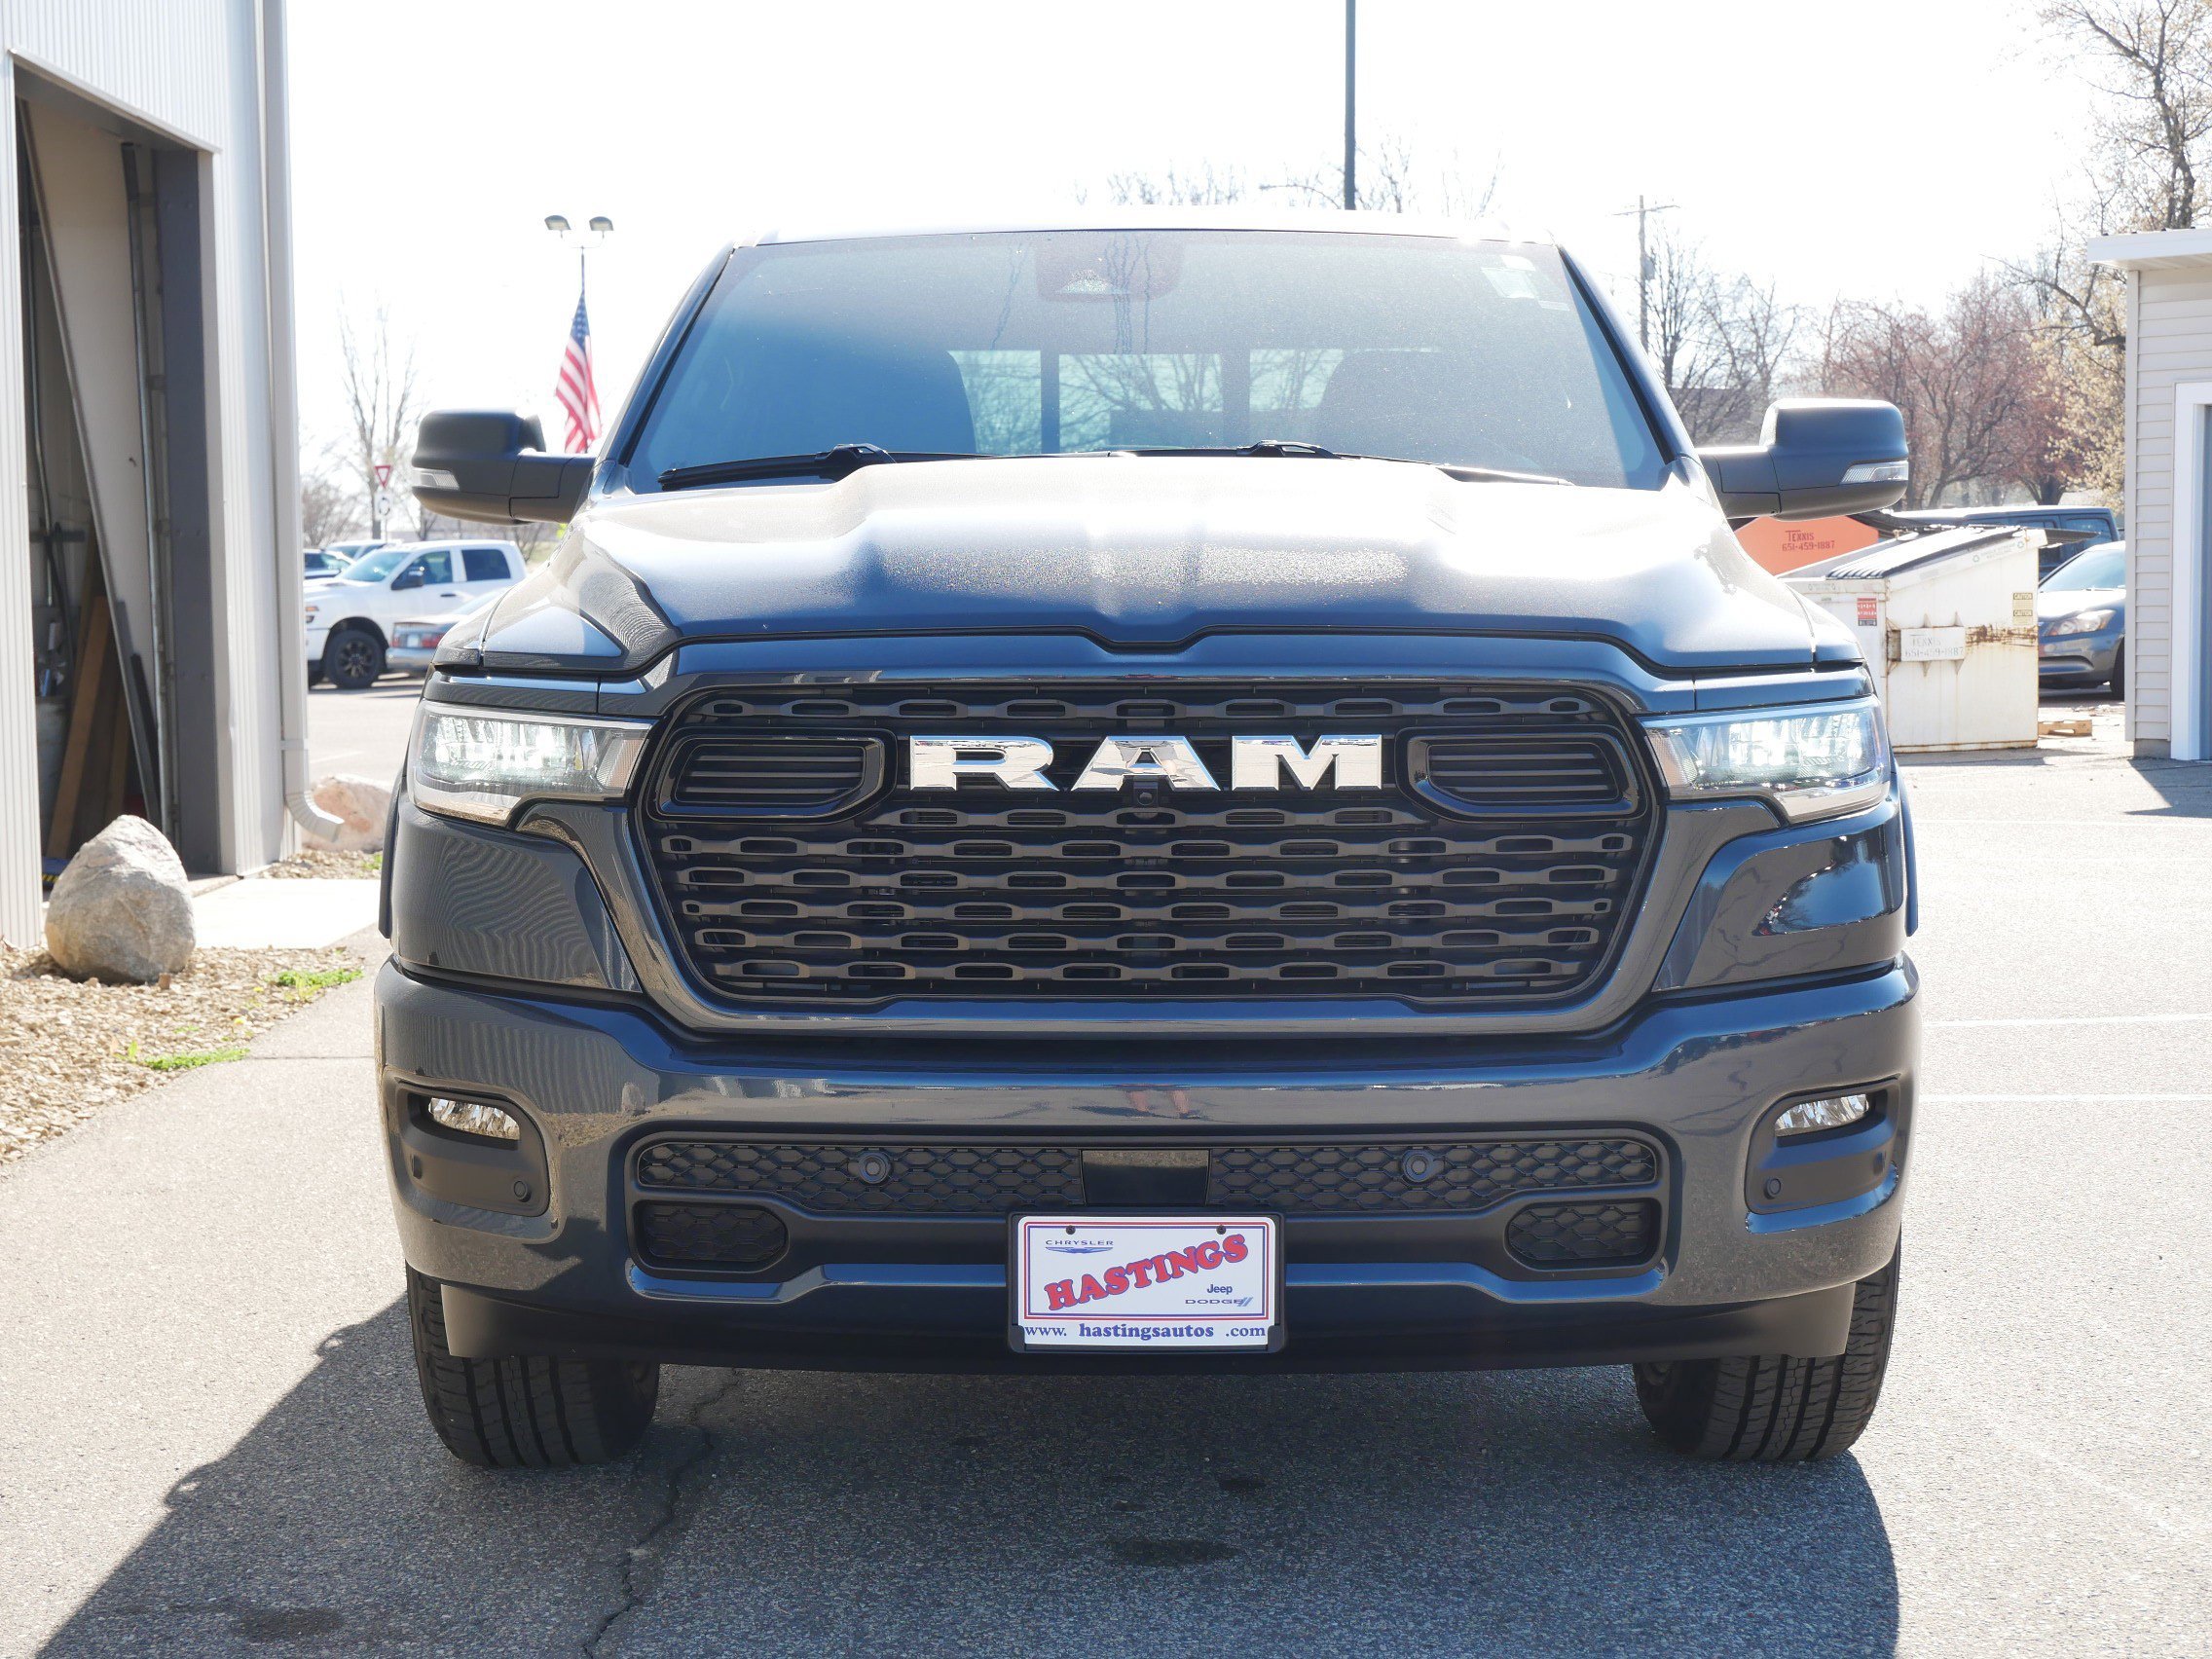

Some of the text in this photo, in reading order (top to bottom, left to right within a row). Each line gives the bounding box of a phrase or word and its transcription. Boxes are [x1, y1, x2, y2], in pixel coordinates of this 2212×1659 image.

[1782, 539, 1835, 552] 651-459-1887
[909, 735, 1384, 792] RAM
[1044, 1233, 1249, 1310] HASTINGS
[1206, 1283, 1234, 1295] Jeep
[1025, 1323, 1266, 1341] www. hastingsautos .com
